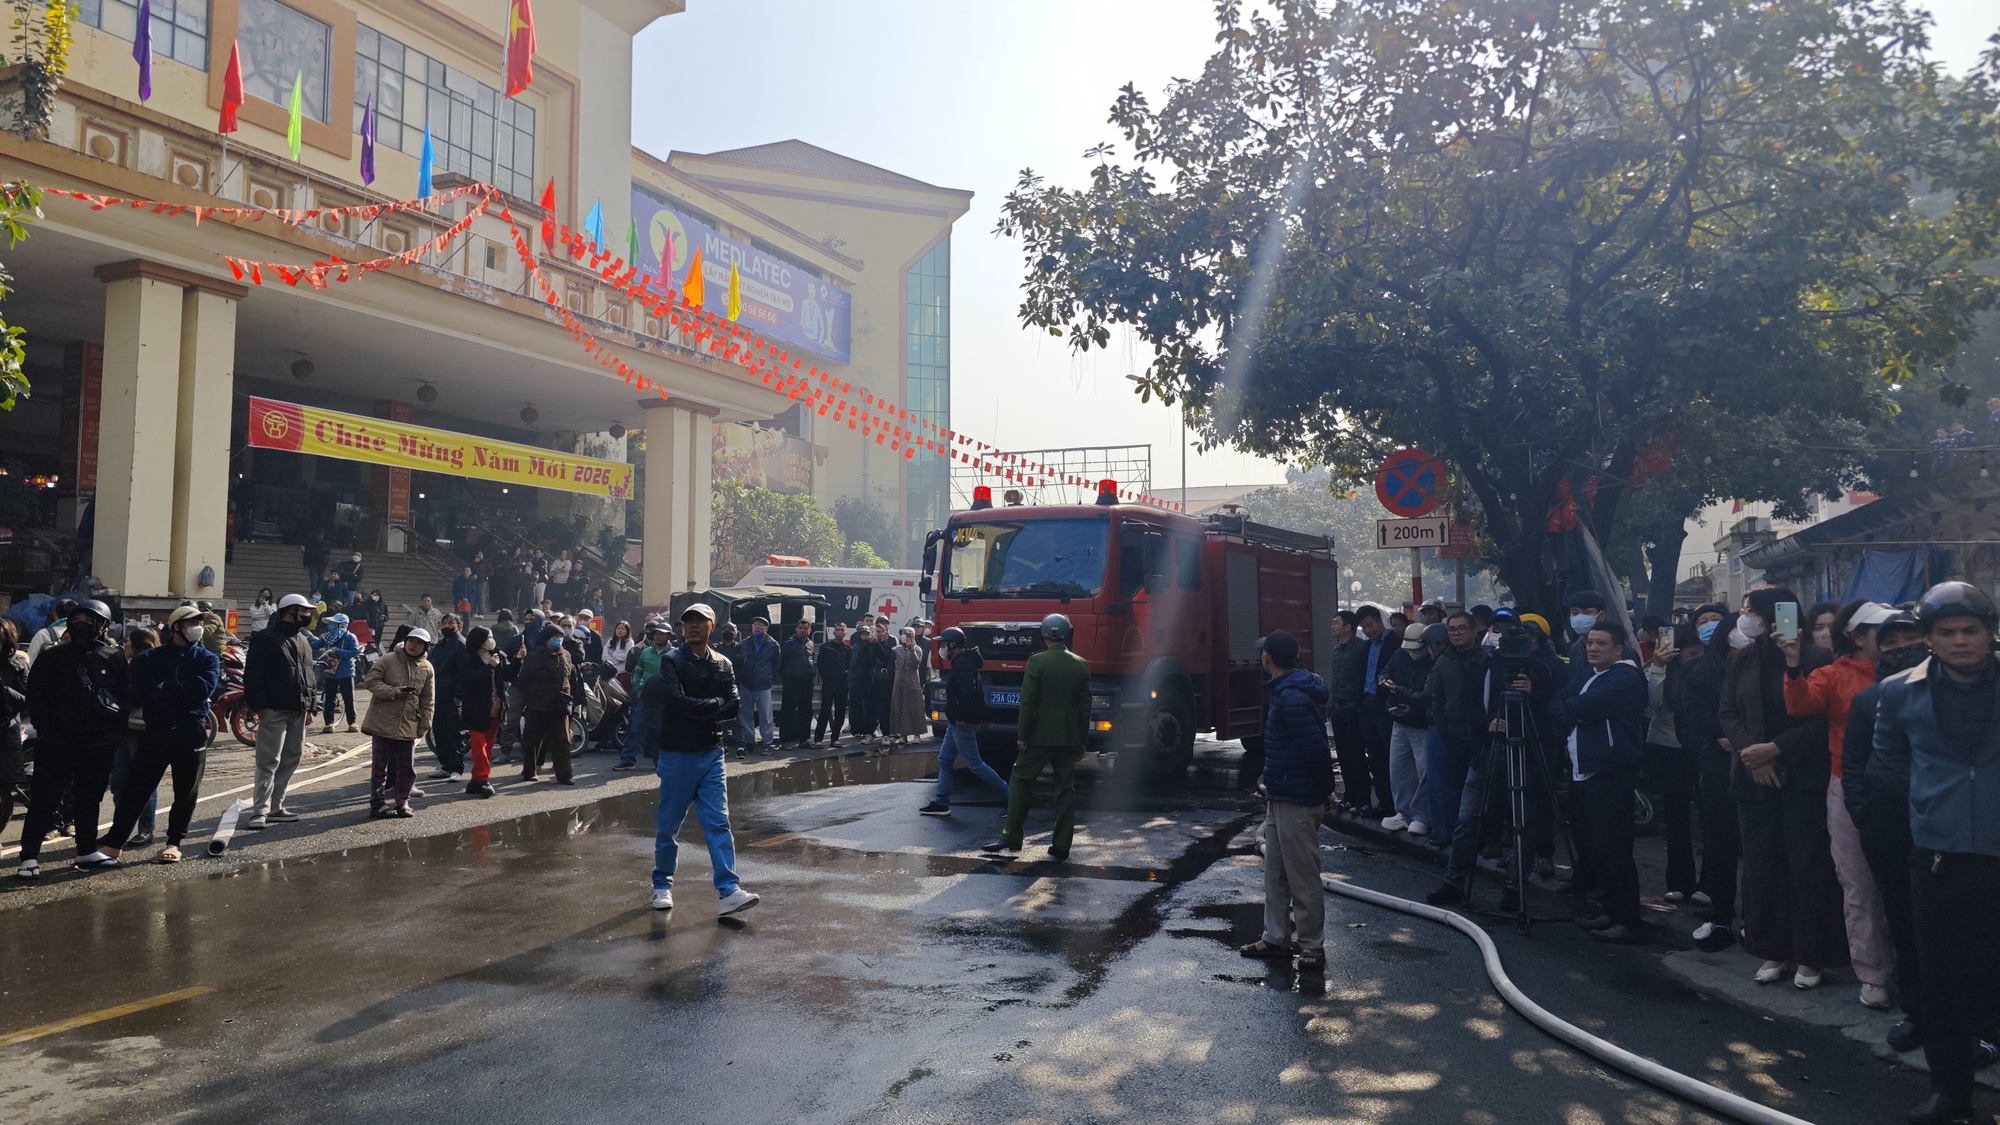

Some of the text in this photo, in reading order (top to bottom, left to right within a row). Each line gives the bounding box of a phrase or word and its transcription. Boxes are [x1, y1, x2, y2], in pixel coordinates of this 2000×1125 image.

[705, 232, 791, 289] MEDLATEC
[747, 305, 757, 315] 56
[757, 308, 767, 319] 56
[767, 311, 776, 323] 56
[315, 420, 611, 486] Chúc Mừng Năm Mới 2026
[957, 527, 979, 543] KV4
[1393, 526, 1434, 540] 200m
[845, 595, 858, 610] 30
[992, 635, 1032, 645] MAN
